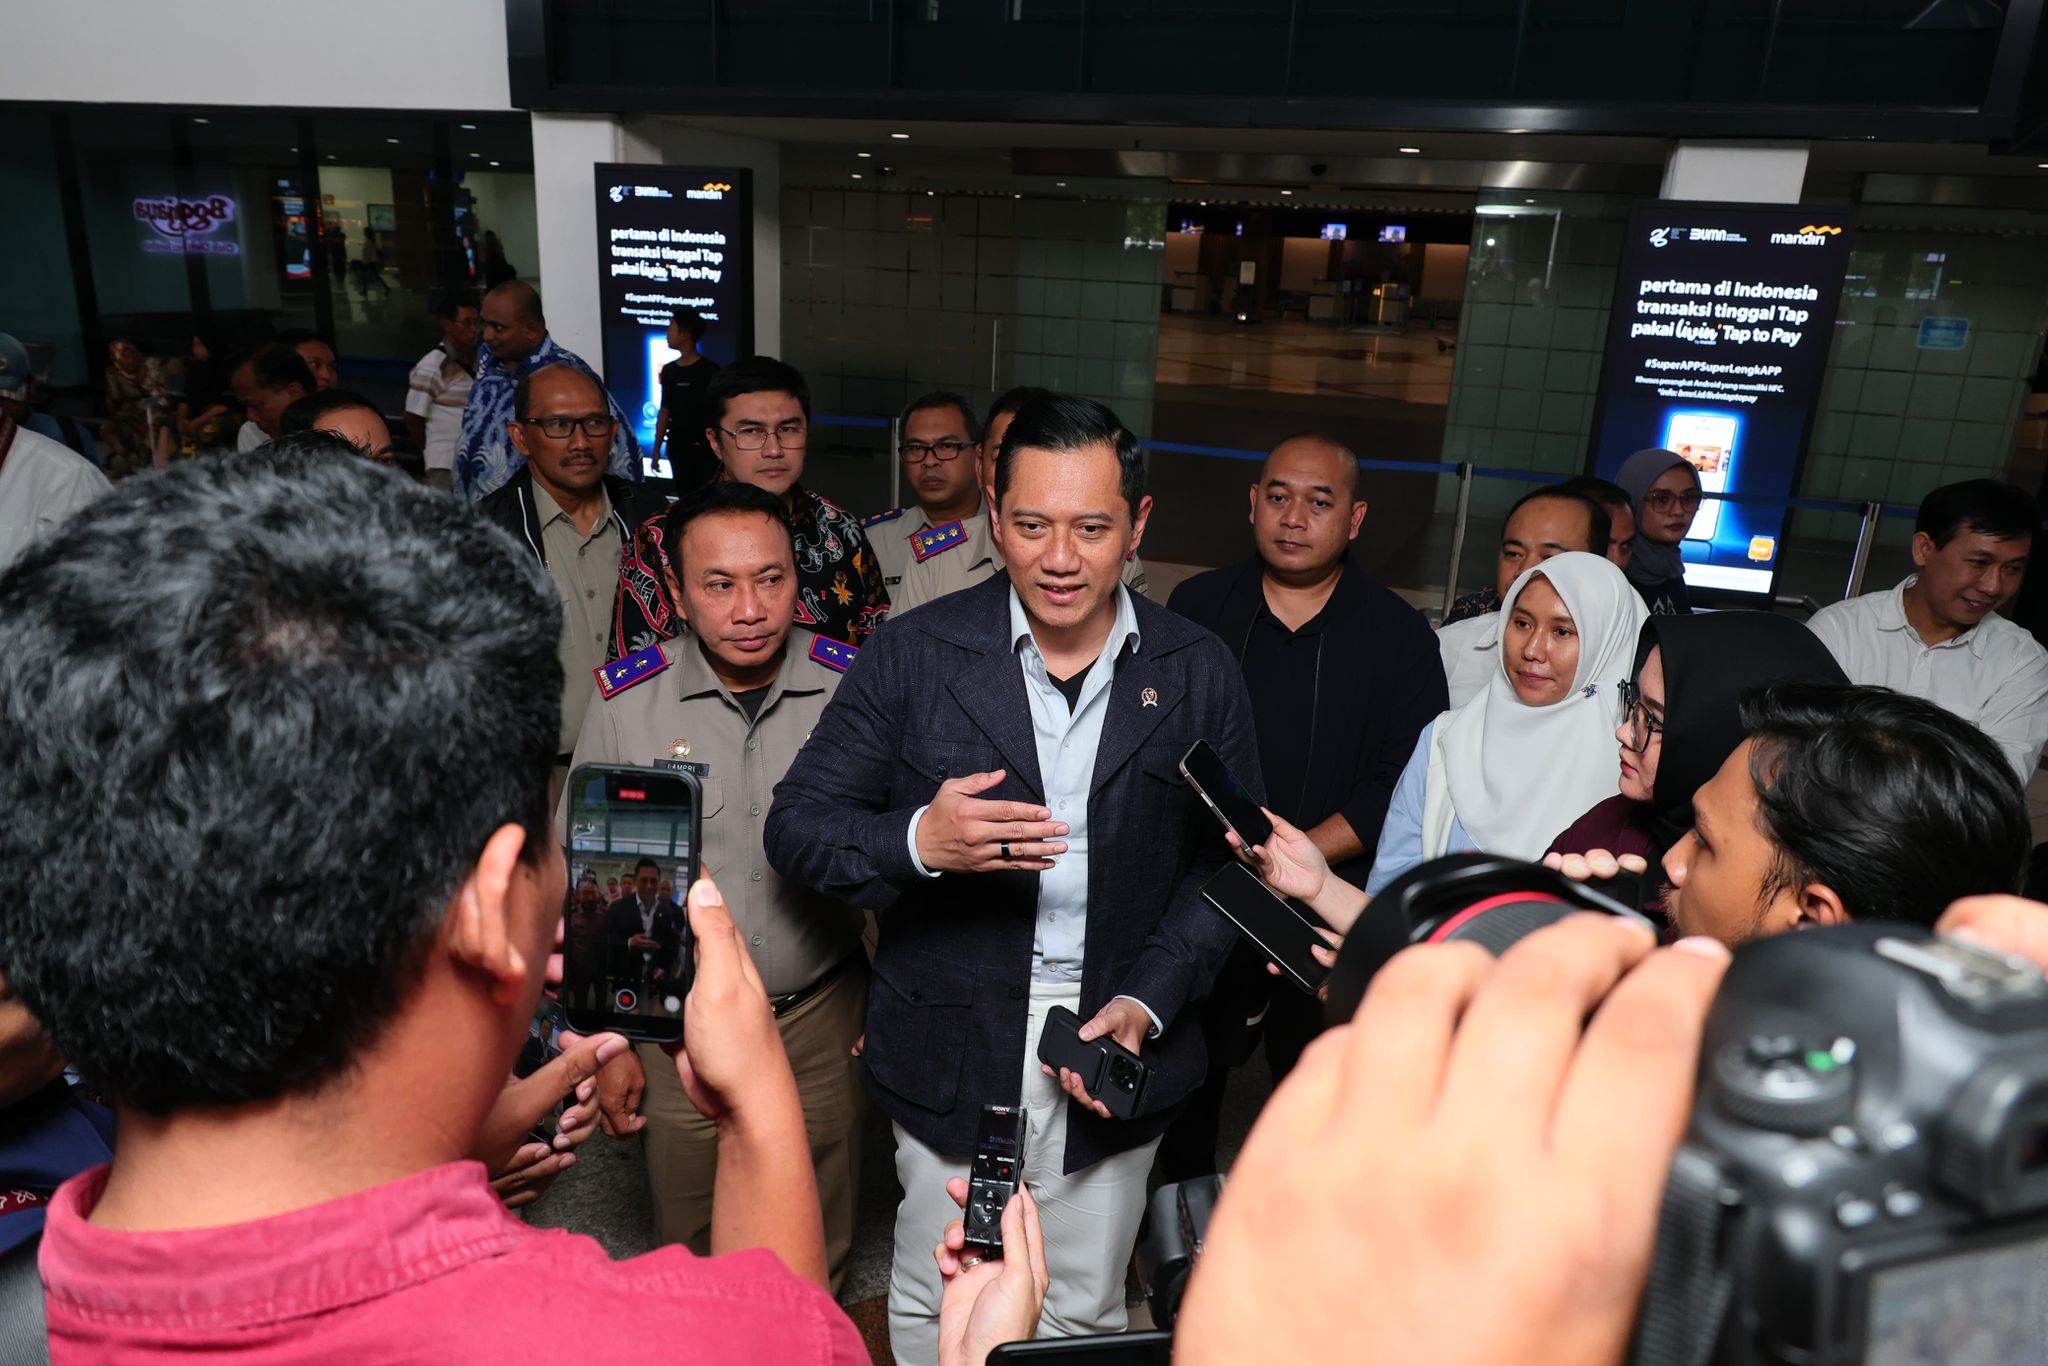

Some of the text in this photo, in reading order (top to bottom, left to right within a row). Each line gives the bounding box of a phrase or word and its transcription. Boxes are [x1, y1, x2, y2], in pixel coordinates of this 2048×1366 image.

[611, 228, 726, 245] pertama di Indonesia
[1770, 231, 1826, 246] mandiri
[611, 245, 723, 265] transaksi tinggal Tap
[611, 262, 640, 277] pakai
[669, 265, 689, 281] Tap
[689, 267, 701, 279] to
[701, 267, 722, 283] Pay
[1640, 279, 1819, 301] pertama di Indonesia
[1637, 299, 1809, 325] transaksi tinggal Tap
[1631, 320, 1675, 338] pakai
[1723, 325, 1751, 344] Tap
[1752, 328, 1770, 342] to
[1771, 328, 1802, 347] Pay
[1645, 358, 1783, 377] #SuperAPPSuperLengkAPP
[1659, 377, 1694, 388] perangkat
[1693, 379, 1721, 389] Android
[1721, 382, 1738, 391] yang
